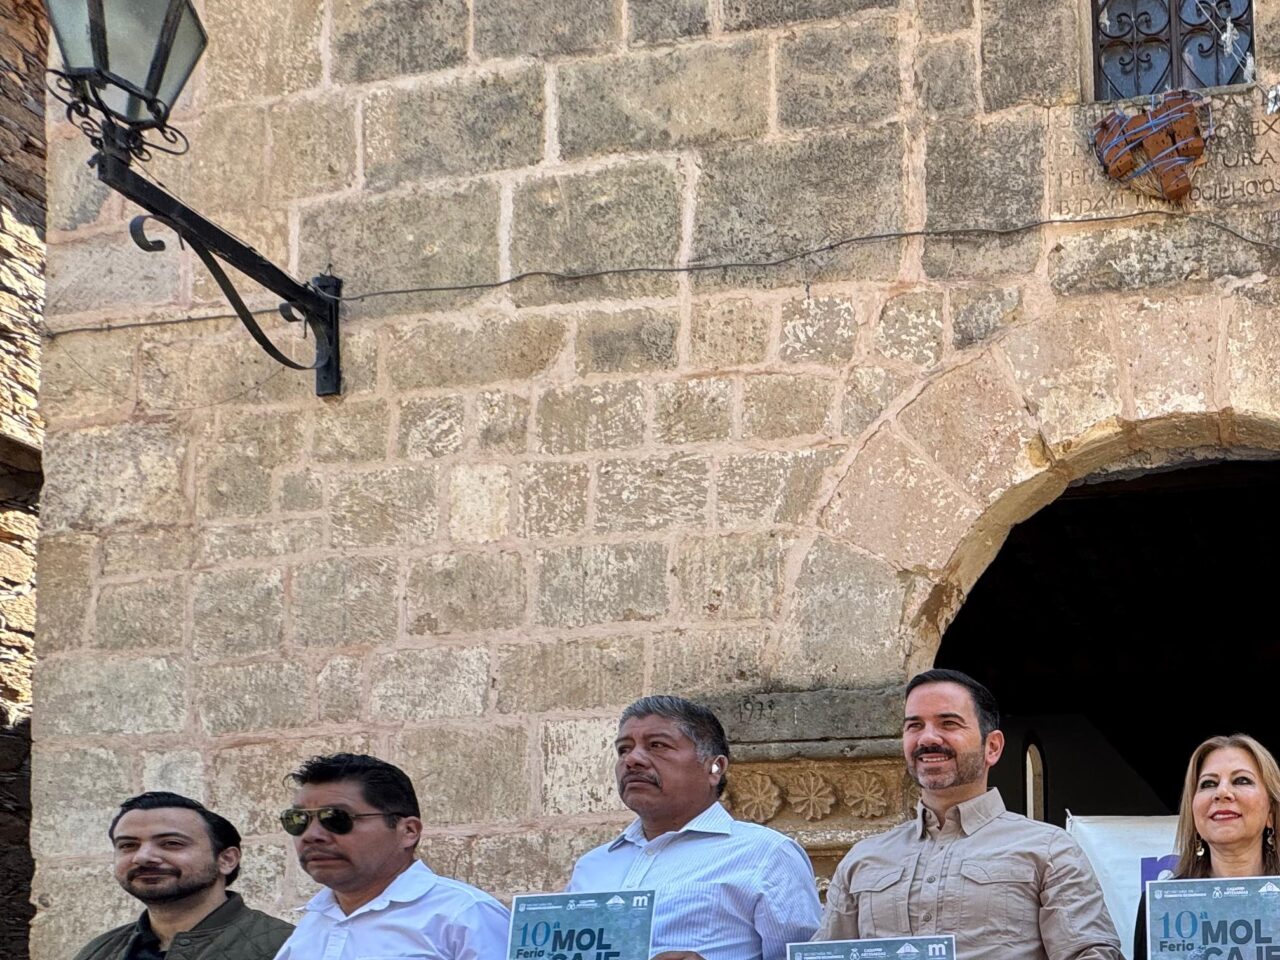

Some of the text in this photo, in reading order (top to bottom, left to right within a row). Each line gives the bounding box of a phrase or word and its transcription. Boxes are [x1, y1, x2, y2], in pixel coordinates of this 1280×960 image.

[1202, 919, 1272, 945] MOL
[551, 928, 611, 951] MOL
[928, 944, 945, 956] m
[1160, 941, 1194, 952] Feria
[516, 949, 544, 959] Feria
